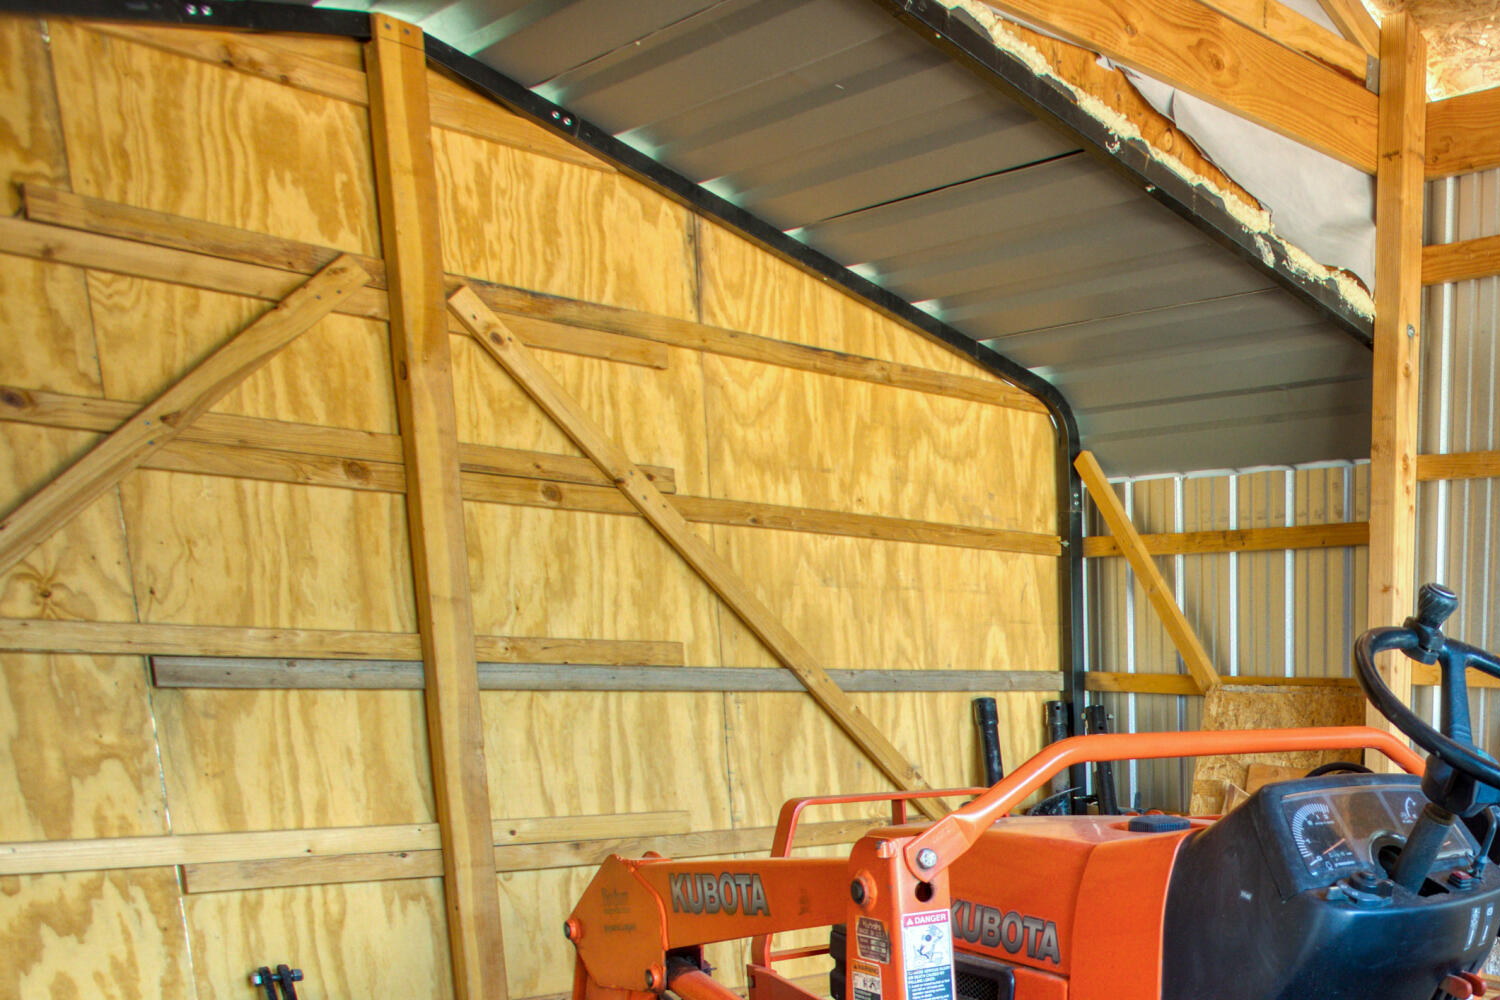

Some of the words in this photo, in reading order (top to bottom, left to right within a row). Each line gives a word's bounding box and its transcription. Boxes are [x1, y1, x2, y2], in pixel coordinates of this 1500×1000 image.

[669, 872, 771, 917] KUBOTA
[914, 913, 946, 925] DANGER
[951, 898, 1061, 964] KUBOTA
